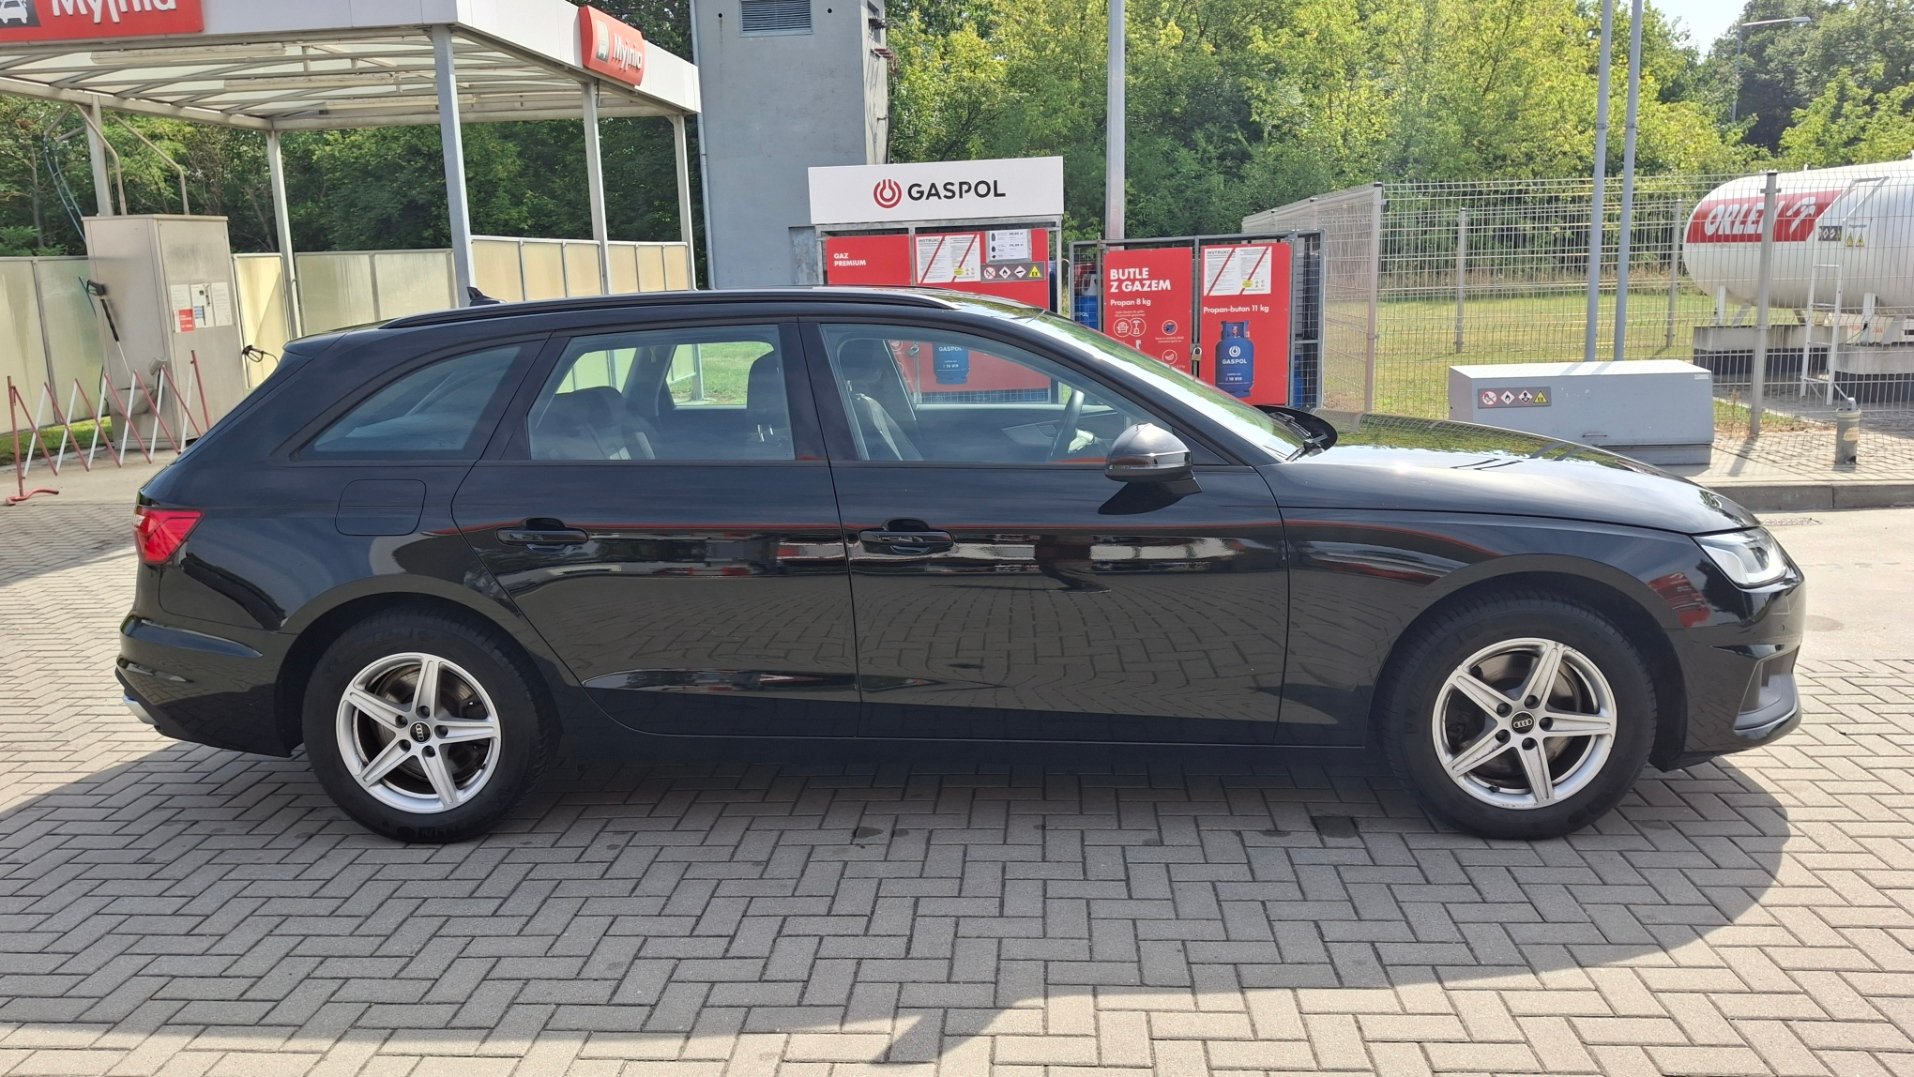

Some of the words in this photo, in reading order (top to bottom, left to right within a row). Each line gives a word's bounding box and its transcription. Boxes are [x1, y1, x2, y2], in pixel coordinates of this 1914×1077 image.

[907, 179, 1006, 201] GASPOL
[834, 259, 866, 267] PREMIUM
[1110, 268, 1149, 280] BUTLE
[1110, 281, 1119, 293] Z
[1121, 279, 1171, 292] GAZEM
[1110, 299, 1135, 307] Propan
[1142, 297, 1151, 307] kg
[1203, 305, 1250, 314] Propan-butan
[1260, 304, 1269, 313] kg
